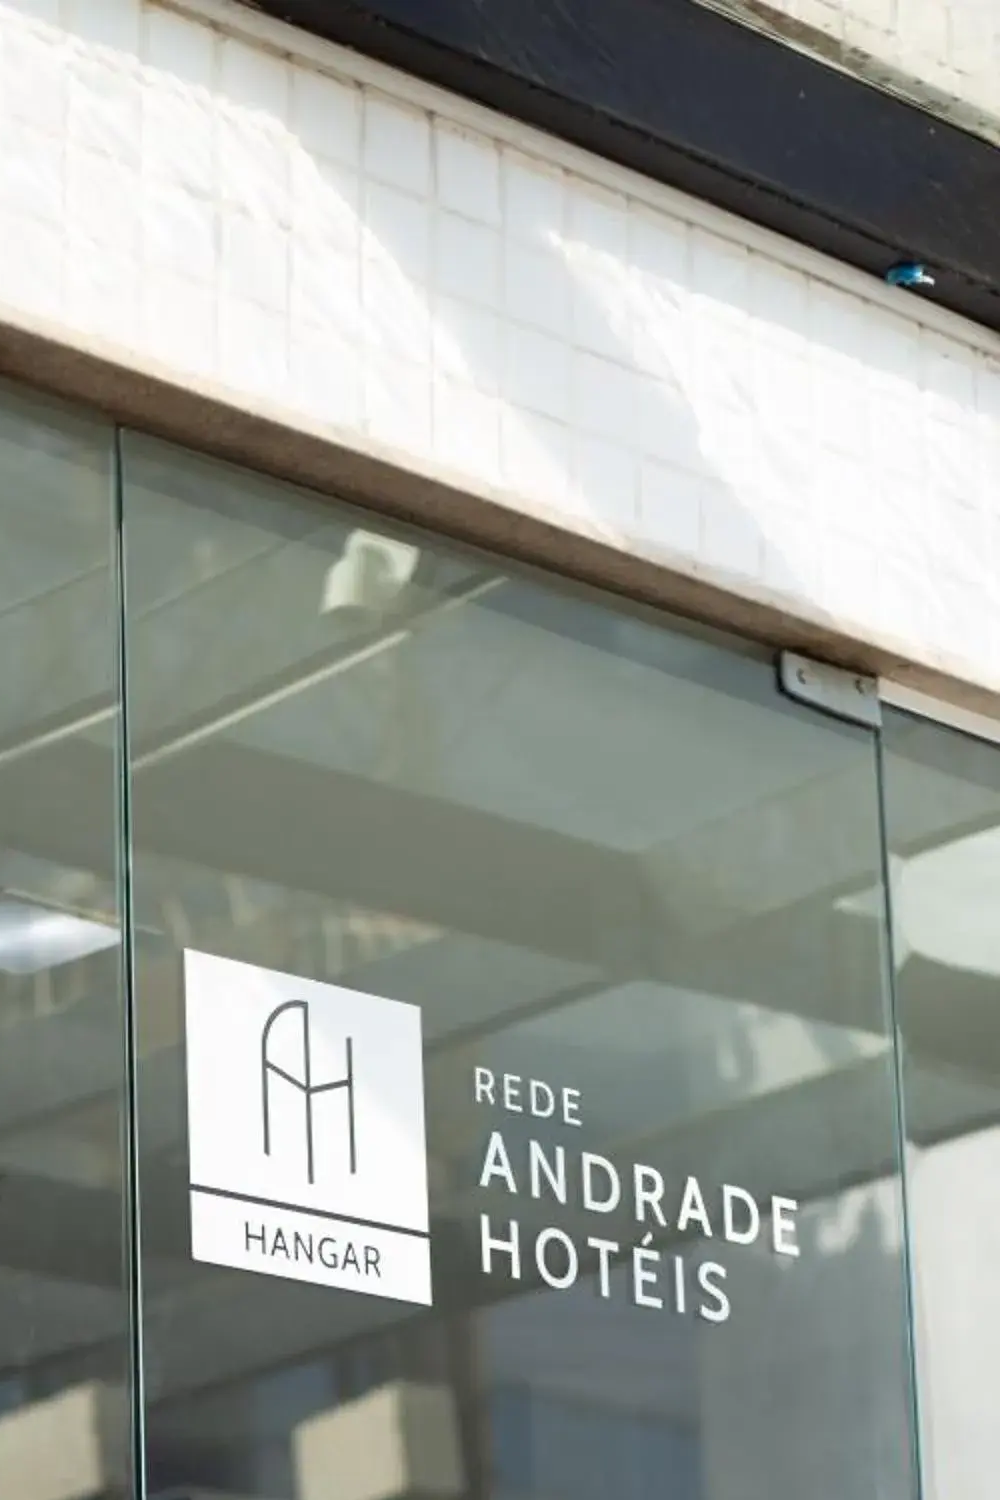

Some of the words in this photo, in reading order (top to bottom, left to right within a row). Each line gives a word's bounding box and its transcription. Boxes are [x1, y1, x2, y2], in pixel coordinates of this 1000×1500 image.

[475, 1066, 582, 1126] REDE
[480, 1131, 800, 1257] ANDRADE
[244, 1221, 382, 1278] HANGAR
[480, 1213, 731, 1322] HOTÉIS
